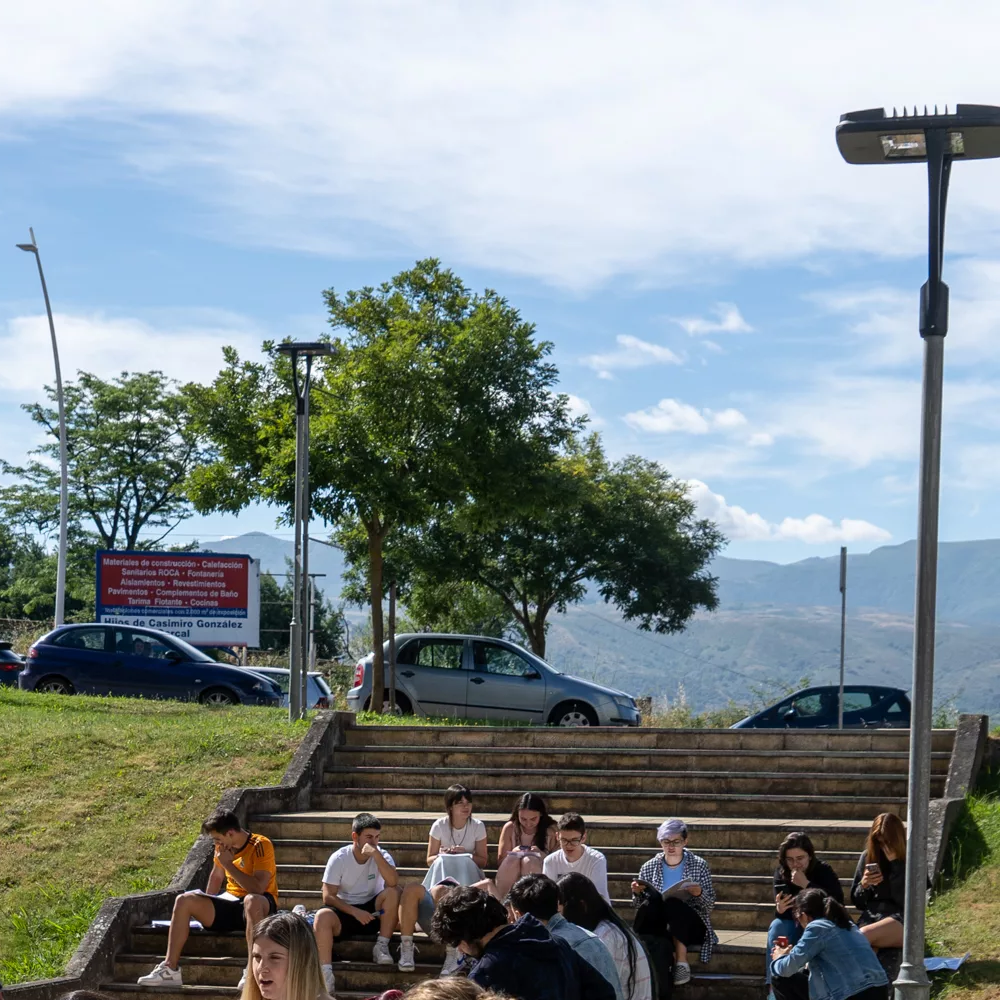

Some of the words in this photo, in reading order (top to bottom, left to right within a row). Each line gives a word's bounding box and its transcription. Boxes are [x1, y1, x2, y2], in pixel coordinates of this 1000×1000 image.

[103, 558, 139, 566] Materiales
[141, 559, 150, 567] de
[151, 559, 196, 568] construcción
[202, 561, 243, 569] Calefacción
[122, 568, 157, 576] Sanitarios
[158, 569, 180, 577] ROCA
[187, 570, 224, 578] Fontanería
[120, 578, 165, 587] Aislamientos
[173, 579, 226, 588] Revestimientos
[108, 587, 148, 596] Pavimentos
[155, 588, 208, 598] Complementos
[220, 590, 239, 598] Baño
[154, 598, 182, 606] Flotante
[190, 598, 219, 607] Cocinas
[132, 618, 145, 627] de
[148, 619, 193, 628] Casimiro
[196, 620, 243, 629] González
